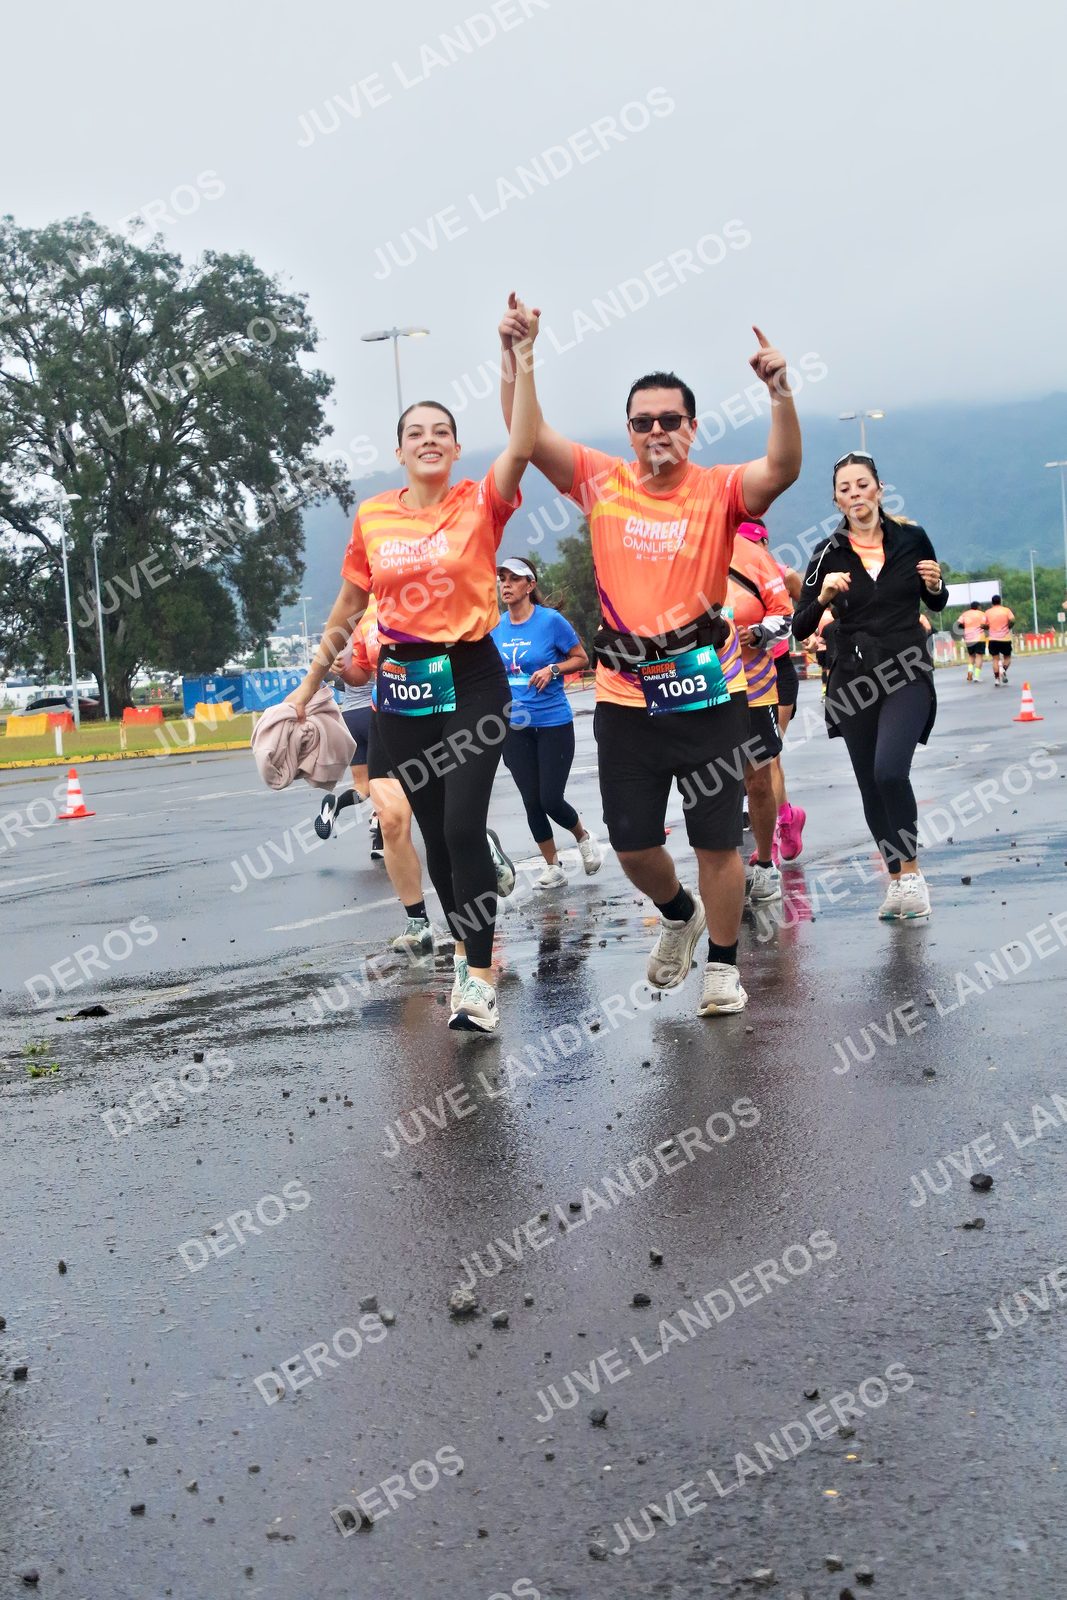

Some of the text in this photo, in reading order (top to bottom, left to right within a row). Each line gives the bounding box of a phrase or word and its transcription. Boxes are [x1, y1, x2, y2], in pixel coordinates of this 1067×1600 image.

[625, 515, 688, 539] CARRERA
[380, 528, 448, 556] CARRERA
[623, 536, 674, 553] OMNILIFE
[380, 551, 435, 569] OMNILIFE
[697, 651, 712, 666] 10K
[428, 661, 443, 674] 10K
[641, 662, 676, 676] CARRERA
[643, 672, 669, 681] OMNILIFE
[389, 683, 433, 700] 1002
[658, 675, 707, 698] 1003
